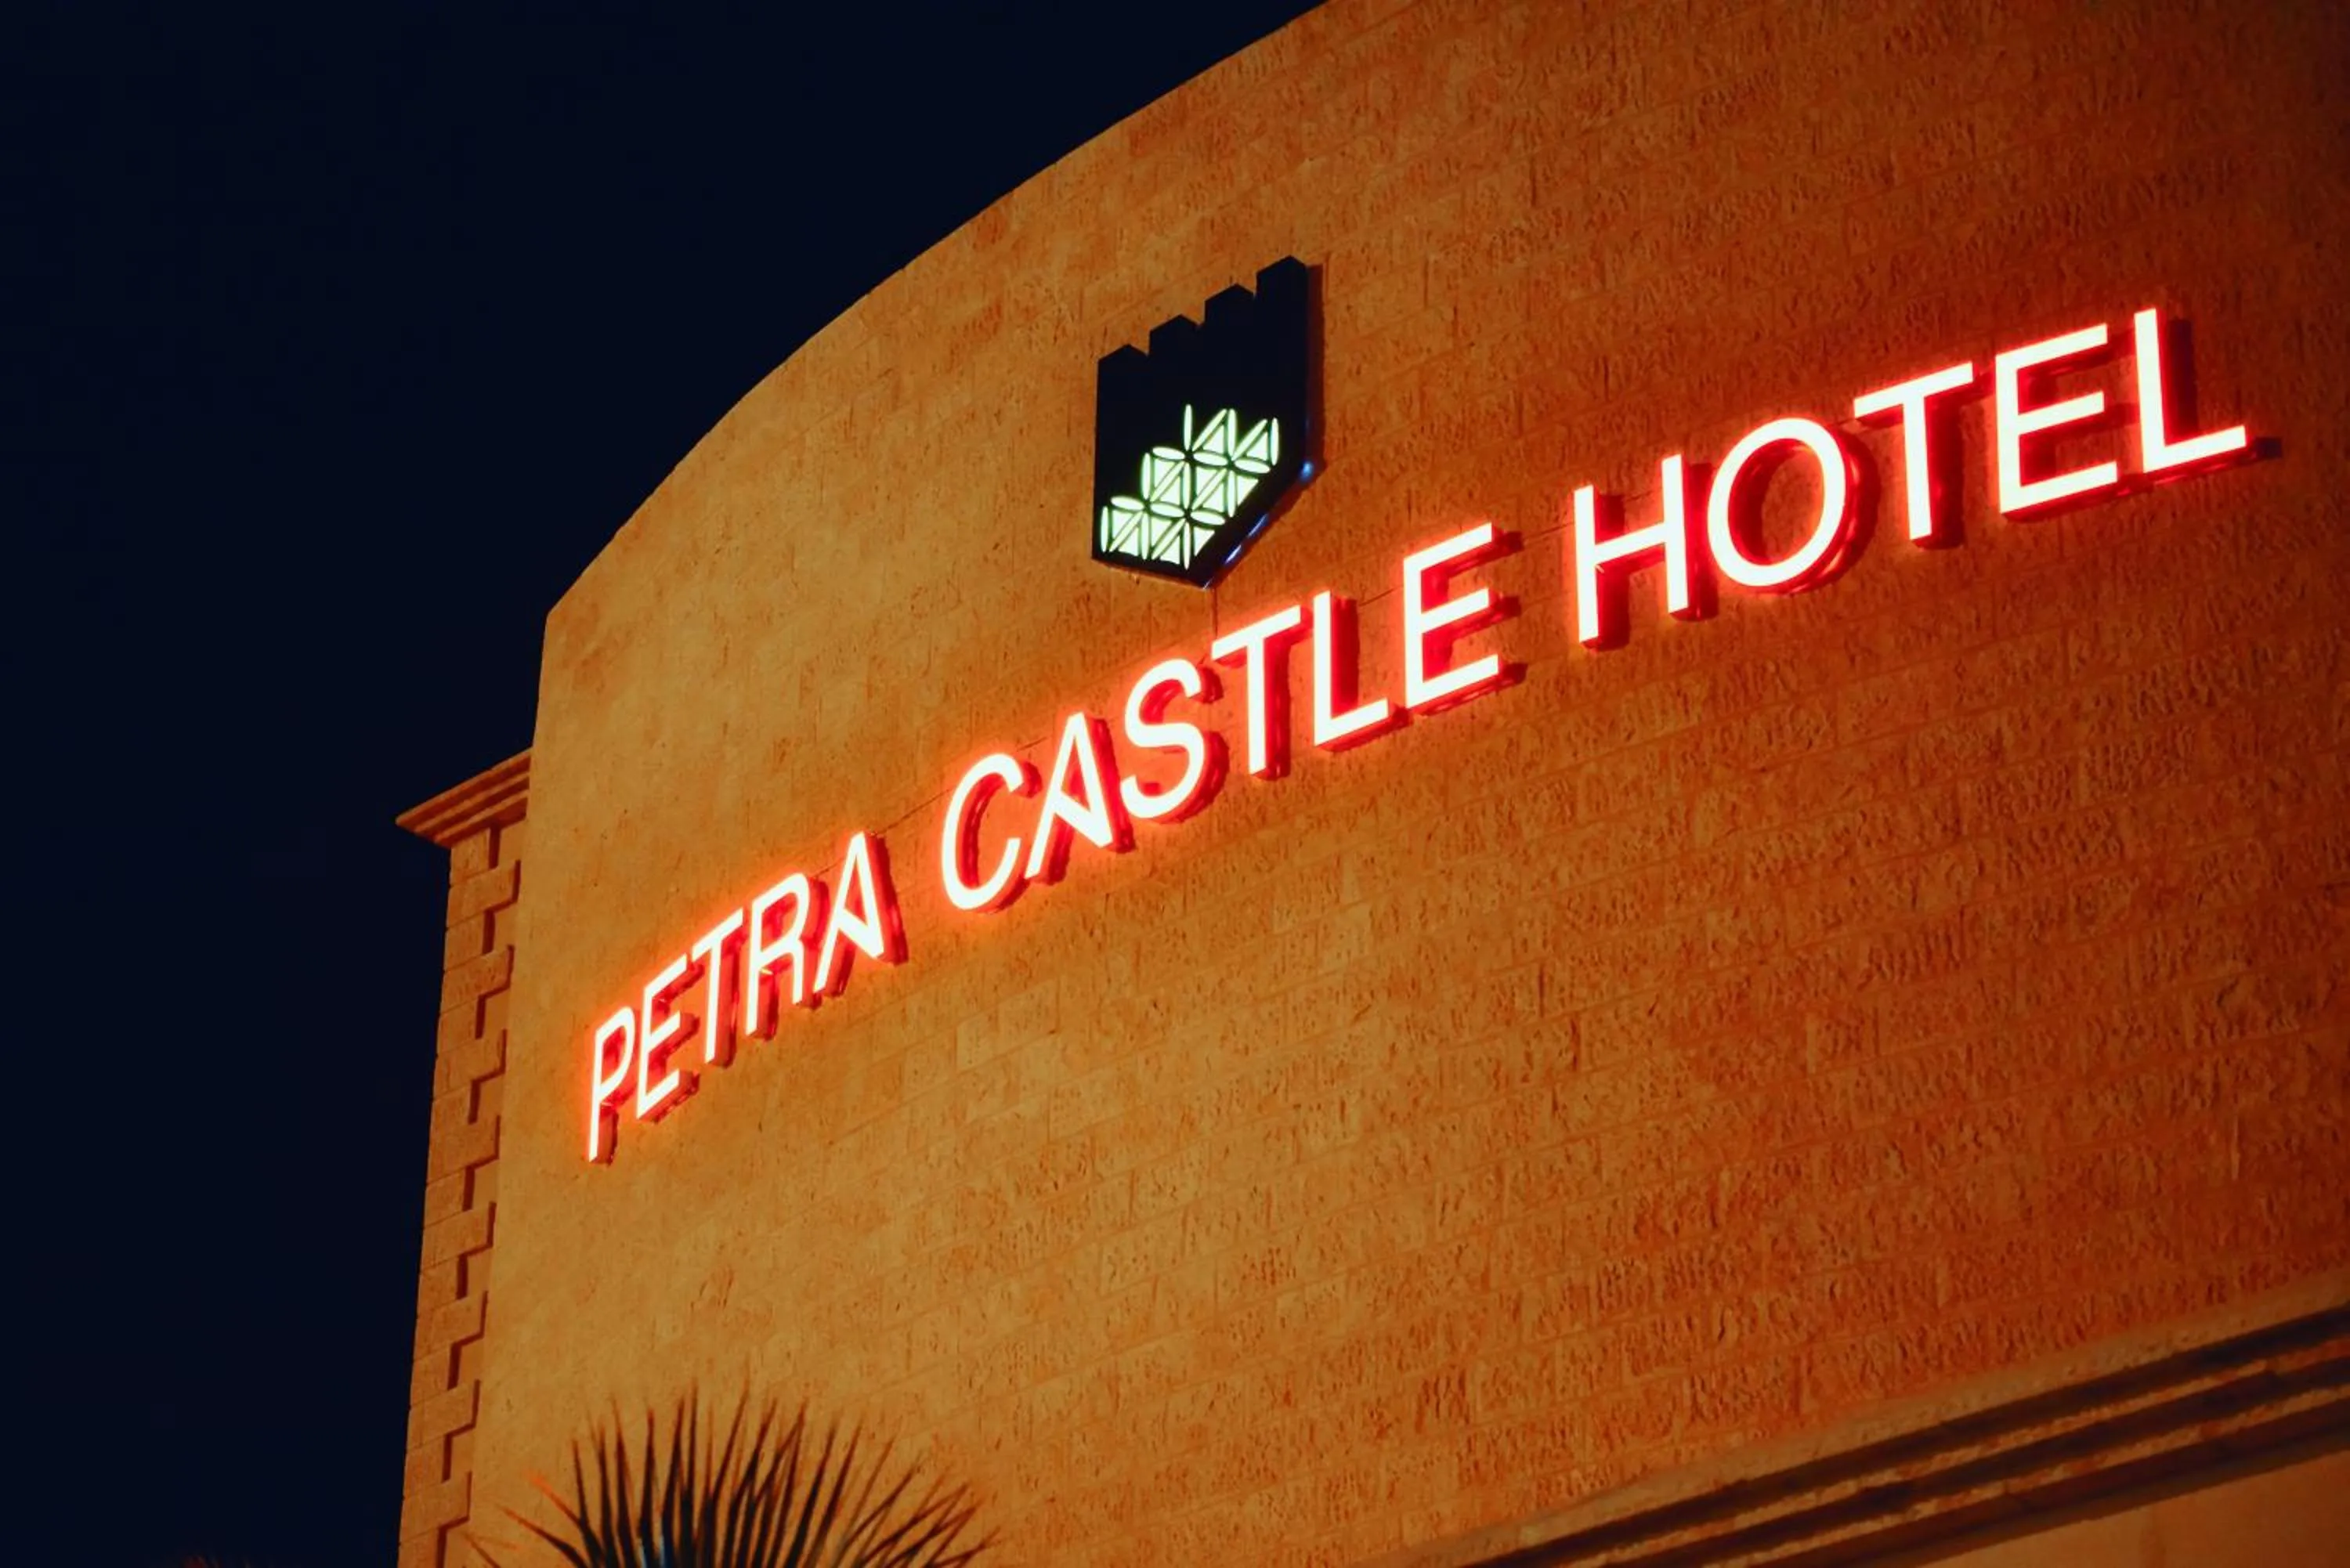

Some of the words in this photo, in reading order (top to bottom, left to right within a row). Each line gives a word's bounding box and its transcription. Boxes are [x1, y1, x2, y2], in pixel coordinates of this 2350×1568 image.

[588, 830, 886, 1162] PETRA
[939, 521, 1500, 911] CASTLE
[1573, 307, 2248, 645] HOTEL
